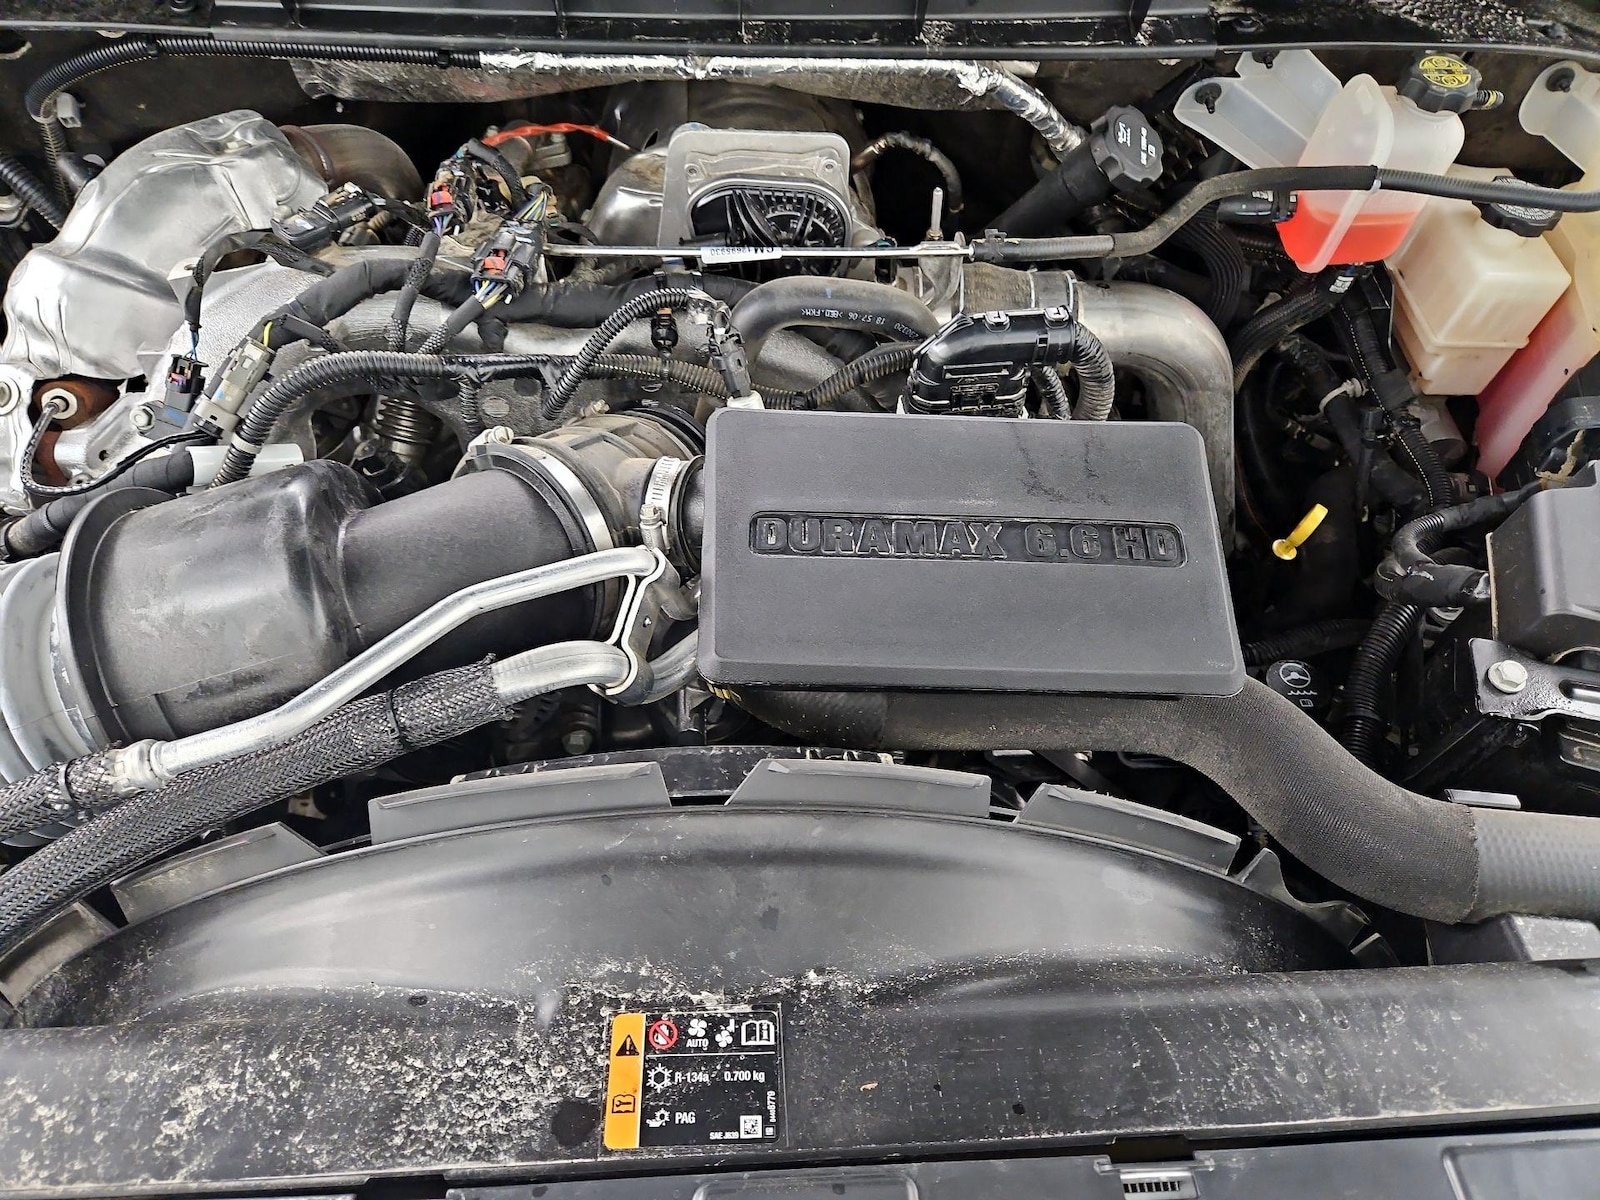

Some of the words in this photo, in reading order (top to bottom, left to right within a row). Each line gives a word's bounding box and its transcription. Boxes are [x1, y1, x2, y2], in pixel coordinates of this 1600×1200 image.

[757, 517, 1008, 560] DURAMAX
[1023, 522, 1102, 561] 6.6
[1111, 526, 1180, 562] HD
[686, 1038, 709, 1048] AUTO
[674, 1071, 709, 1083] R-134a
[724, 1070, 751, 1082] 0.700
[753, 1070, 765, 1083] kg
[675, 1112, 696, 1125] PAG
[709, 1131, 723, 1140] SAE
